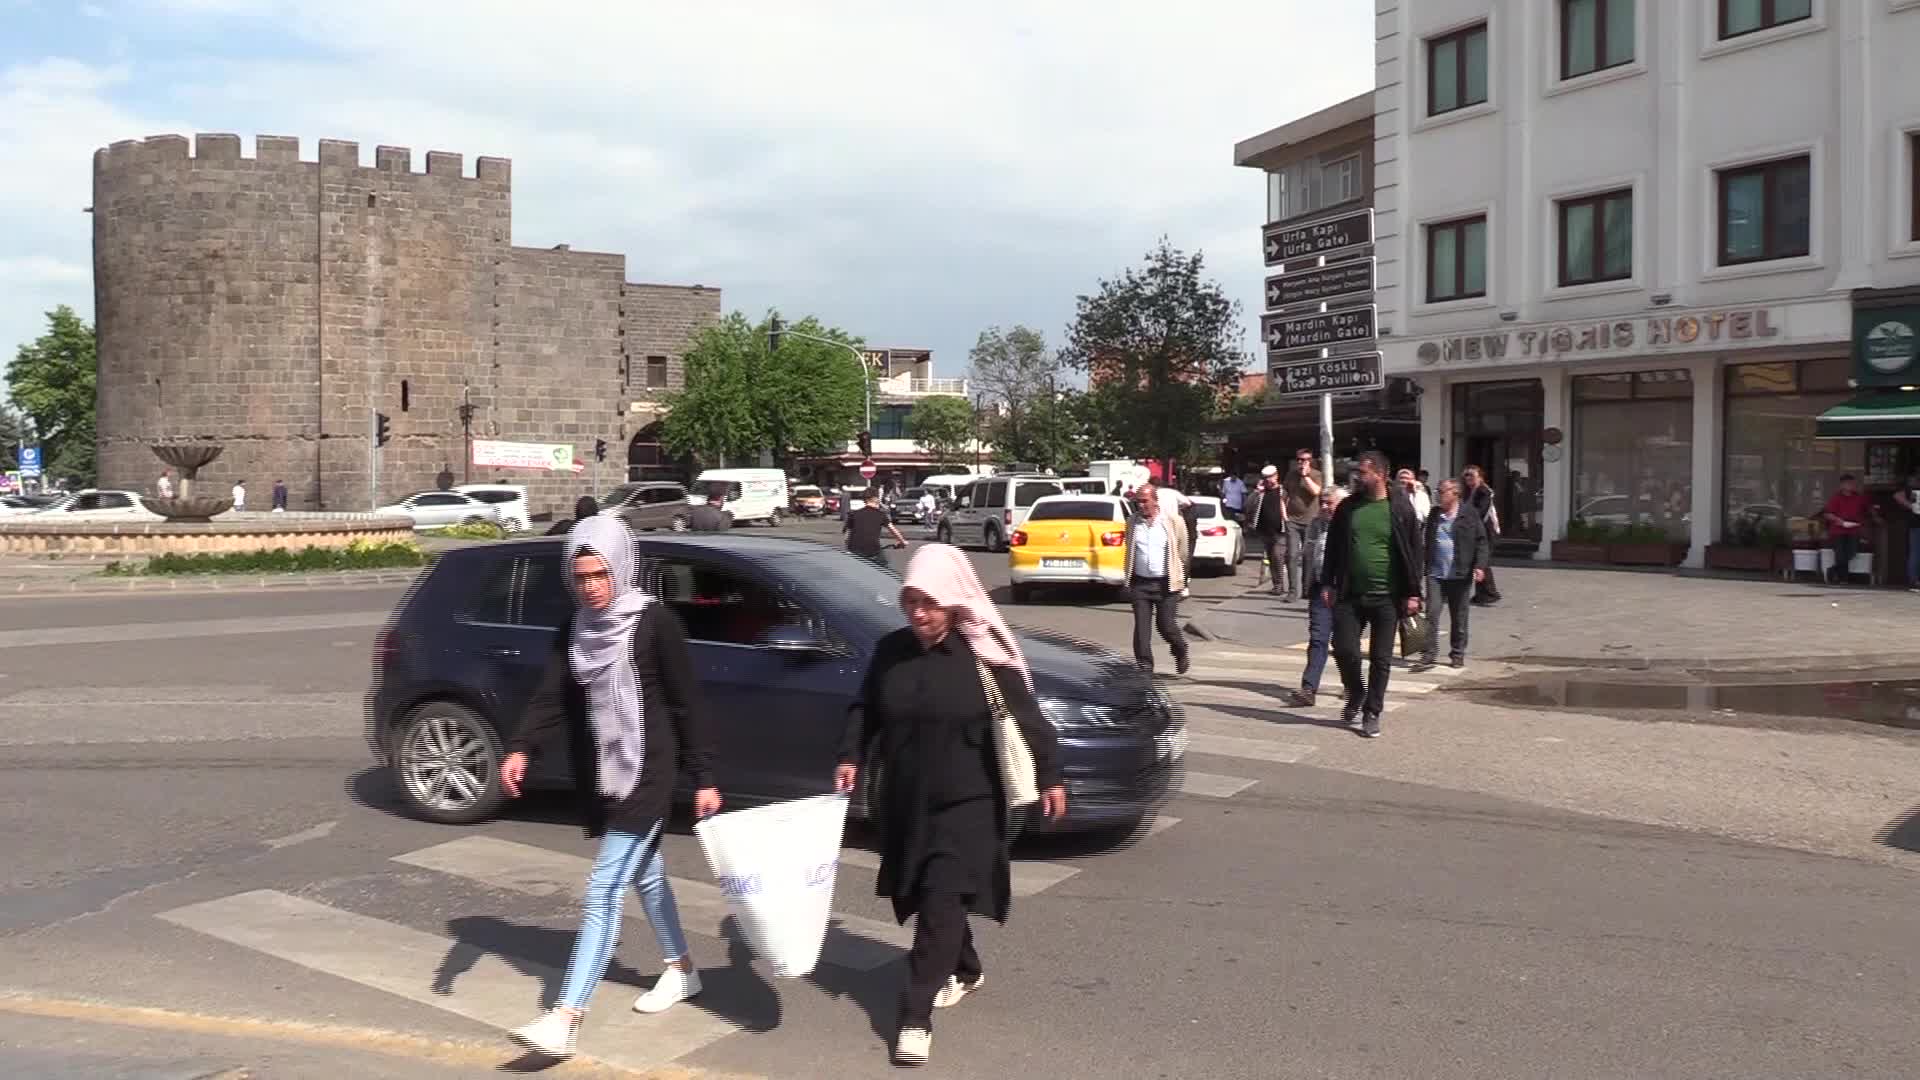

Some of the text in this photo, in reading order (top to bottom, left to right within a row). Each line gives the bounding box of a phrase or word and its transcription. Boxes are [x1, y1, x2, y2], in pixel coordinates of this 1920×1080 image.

[1282, 230, 1307, 243] Urfa
[1317, 232, 1349, 248] Gate)
[1285, 319, 1326, 333] Mardin
[1285, 324, 1370, 347] (Mardin Gate)
[1443, 334, 1509, 361] NEW
[1648, 310, 1779, 345] HOTEL
